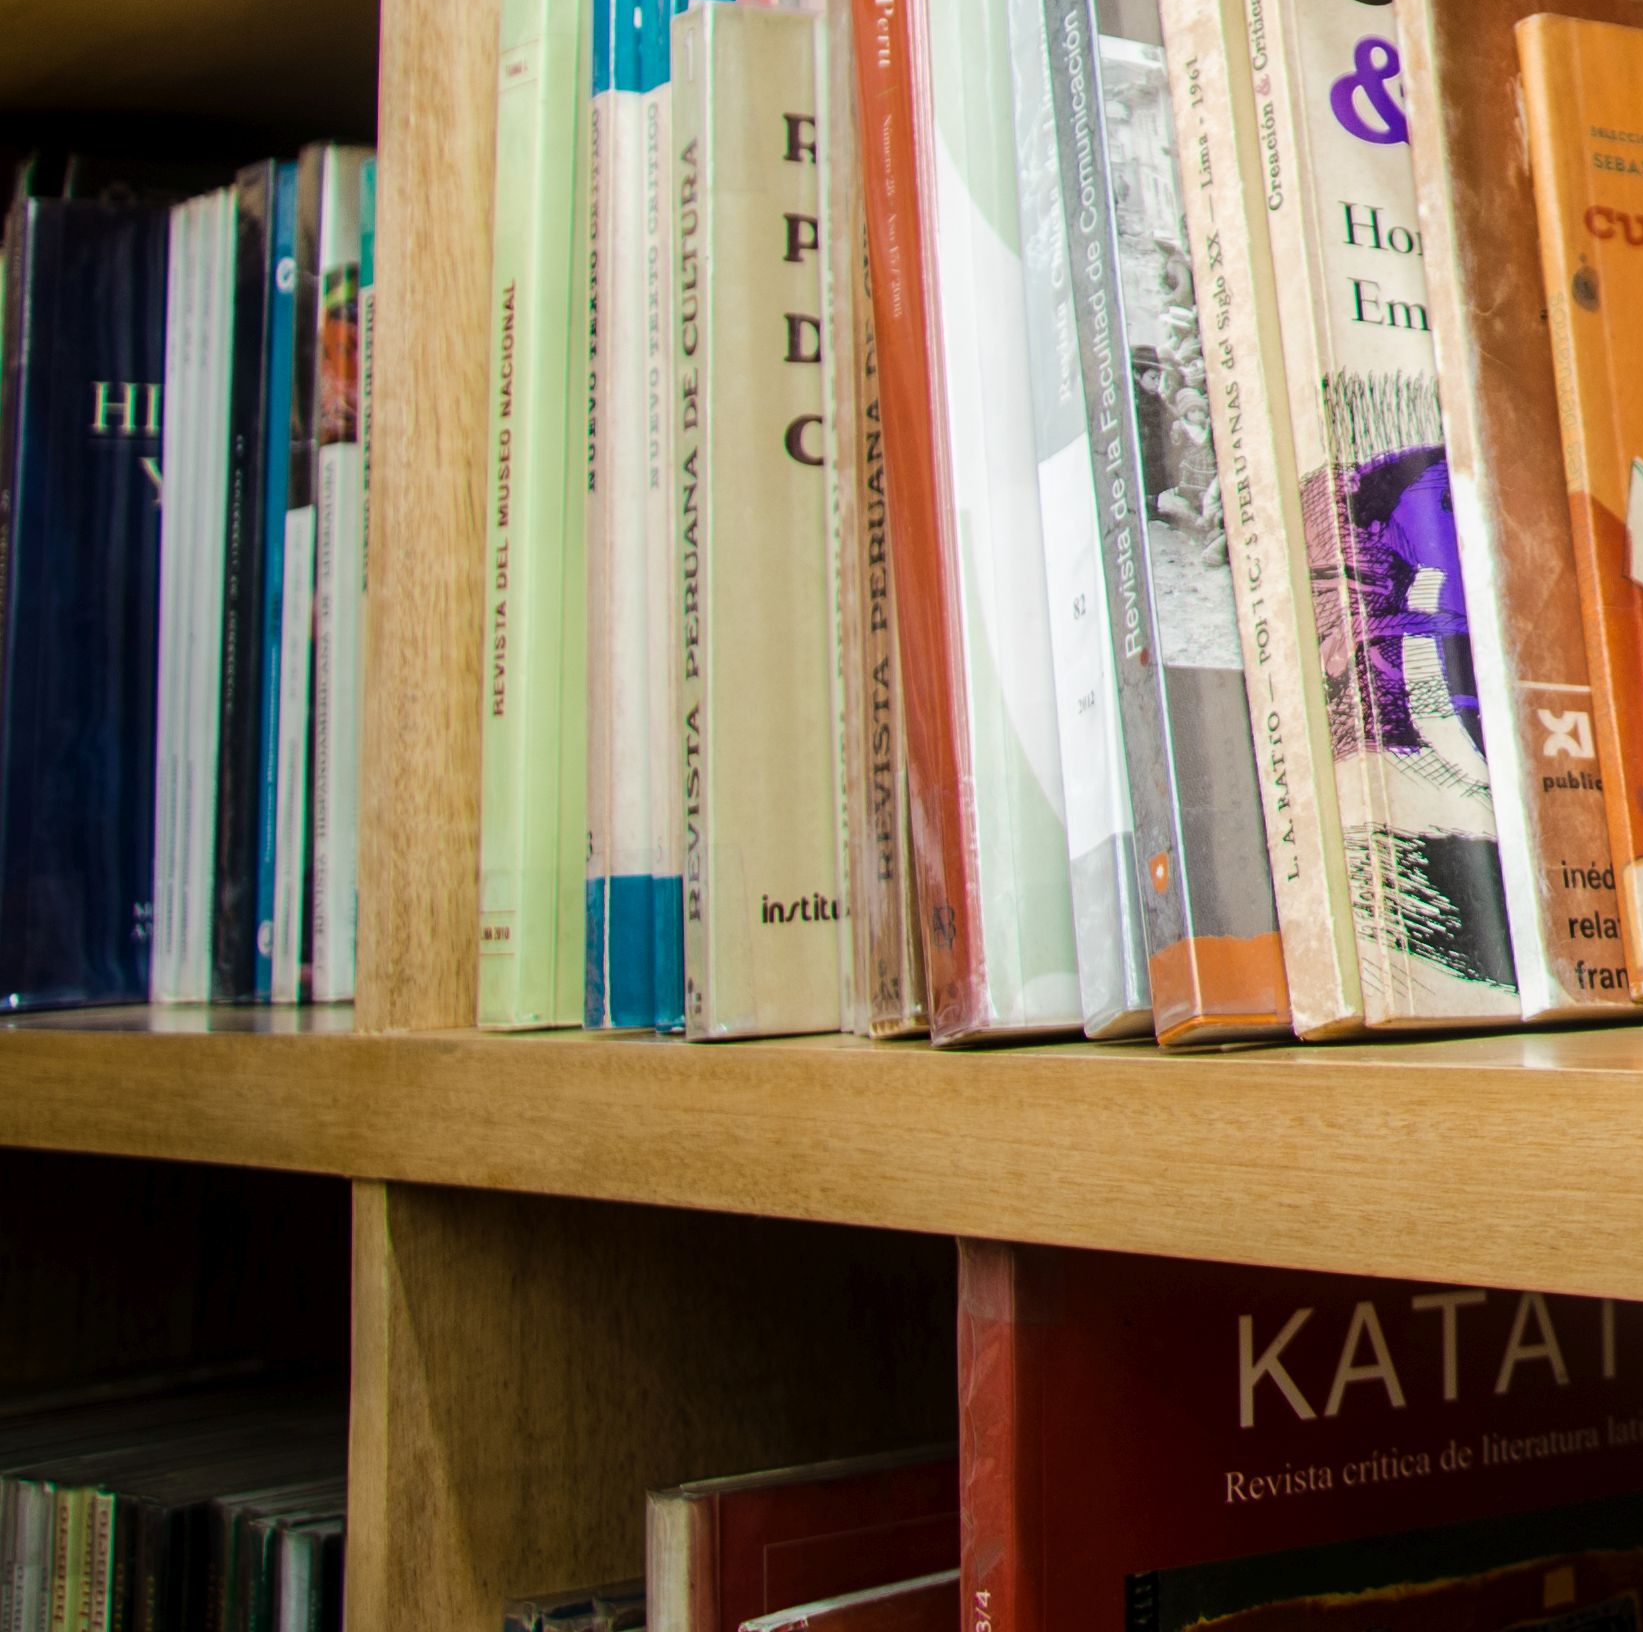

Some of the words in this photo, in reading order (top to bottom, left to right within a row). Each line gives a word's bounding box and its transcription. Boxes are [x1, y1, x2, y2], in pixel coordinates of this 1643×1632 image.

[1061, 9, 1100, 235] Comunicación
[1254, 73, 1272, 97] &
[1198, 137, 1217, 191] Lima
[1261, 100, 1285, 212] Creación
[681, 136, 700, 356] CULTURA
[1081, 241, 1105, 276] de
[1202, 218, 1222, 255] XX
[500, 277, 518, 419] NACIONAL
[649, 244, 660, 357] TEXTO
[1209, 268, 1234, 326] Siglo
[682, 368, 699, 429] DE
[1087, 289, 1121, 433] Facultad
[497, 428, 513, 528] MUSEO
[650, 366, 660, 491] NUEVO
[1101, 438, 1122, 471] la
[863, 399, 890, 633] PERUANA
[1105, 477, 1129, 520] de
[495, 537, 510, 592] DEL
[683, 446, 700, 682] PERUANA
[1071, 594, 1087, 621] 82
[1108, 527, 1143, 659] Revista
[491, 600, 508, 718] REVISTA
[685, 706, 701, 922] REVISTA
[869, 657, 893, 881] REVISTA
[1225, 1463, 1334, 1506] Revista
[1342, 1448, 1431, 1487] crítica
[1438, 1438, 1475, 1472] de
[1481, 1422, 1601, 1466] literatura
